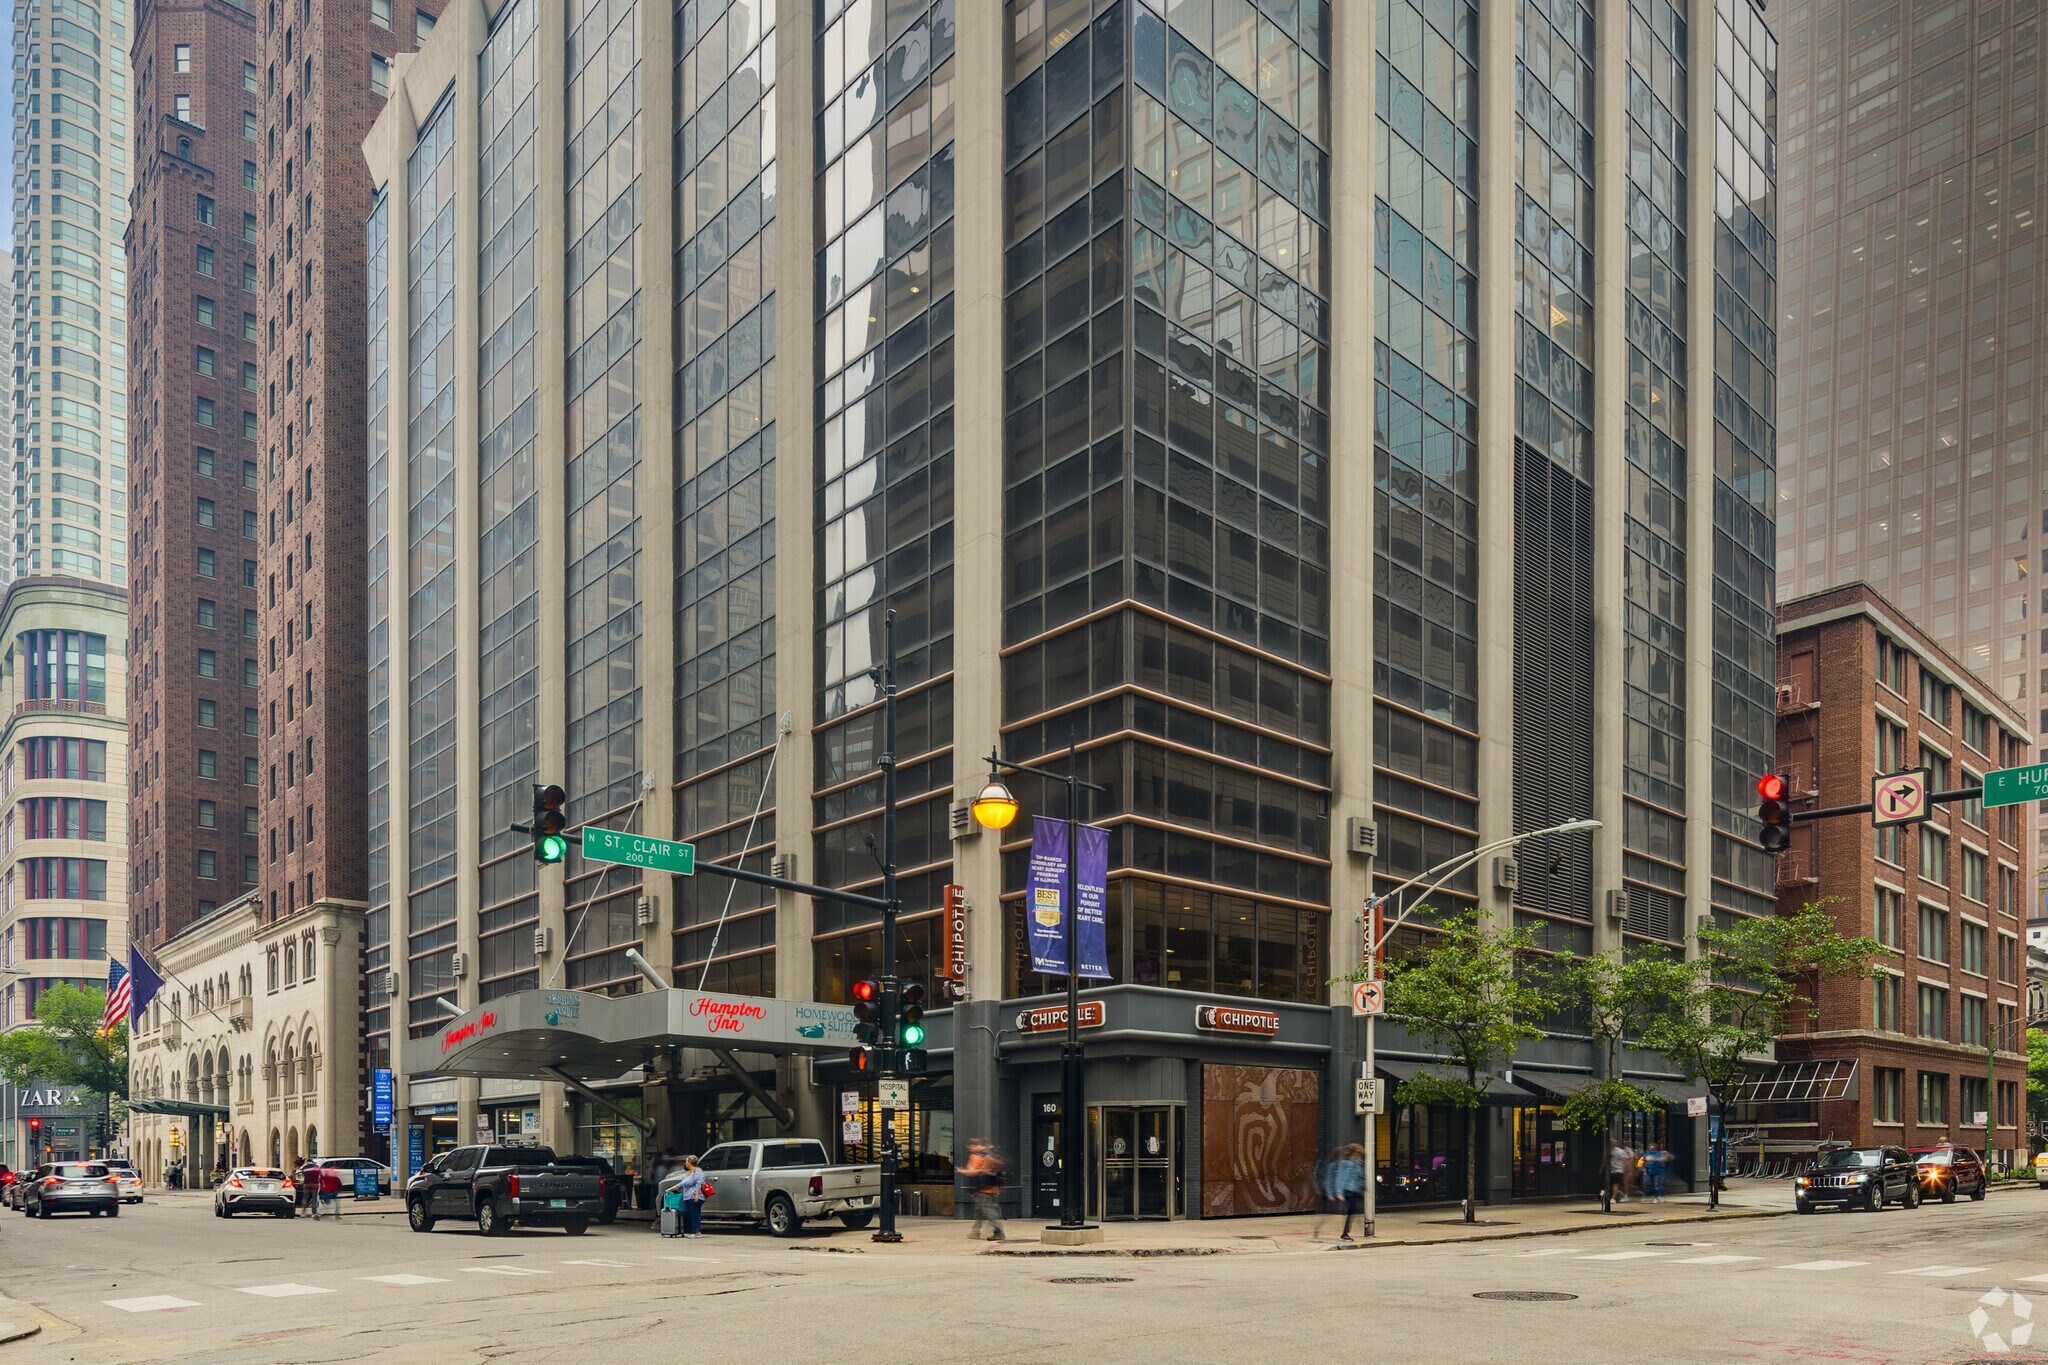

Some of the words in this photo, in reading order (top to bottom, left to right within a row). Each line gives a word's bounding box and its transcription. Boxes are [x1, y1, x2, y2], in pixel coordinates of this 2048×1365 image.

[1998, 777, 2006, 787] E
[588, 833, 595, 842] N
[604, 834, 624, 850] ST.
[633, 839, 671, 857] CLAIR
[678, 848, 690, 858] ST
[625, 852, 644, 863] 200
[648, 855, 654, 865] E
[1030, 859, 1057, 868] CARDIOLOGY
[1035, 854, 1063, 863] TOP-RANKED
[1036, 871, 1059, 879] PROGRAM
[1045, 866, 1066, 874] SURGERY
[1077, 883, 1105, 894] RELENTLESS
[1036, 889, 1059, 900] BEST
[1080, 899, 1100, 908] PURSUIT
[1084, 907, 1103, 916] BETTER
[952, 888, 965, 975] CHIPOTLE
[1080, 963, 1103, 971] BETTER
[689, 997, 767, 1020] Hampton
[1030, 1007, 1092, 1026] CHIPOLE
[1221, 1012, 1280, 1030] CHIPOTLE
[708, 1014, 745, 1033] Inn
[827, 1020, 855, 1033] SUITE
[441, 1021, 476, 1055] Hampton
[476, 1010, 497, 1036] Inn
[880, 1083, 907, 1091] HOSPITAL
[1358, 1081, 1374, 1090] ONE
[20, 1089, 82, 1107] ZARA
[1357, 1090, 1375, 1099] WAY
[880, 1099, 894, 1107] QUIET
[1042, 1103, 1057, 1113] 160
